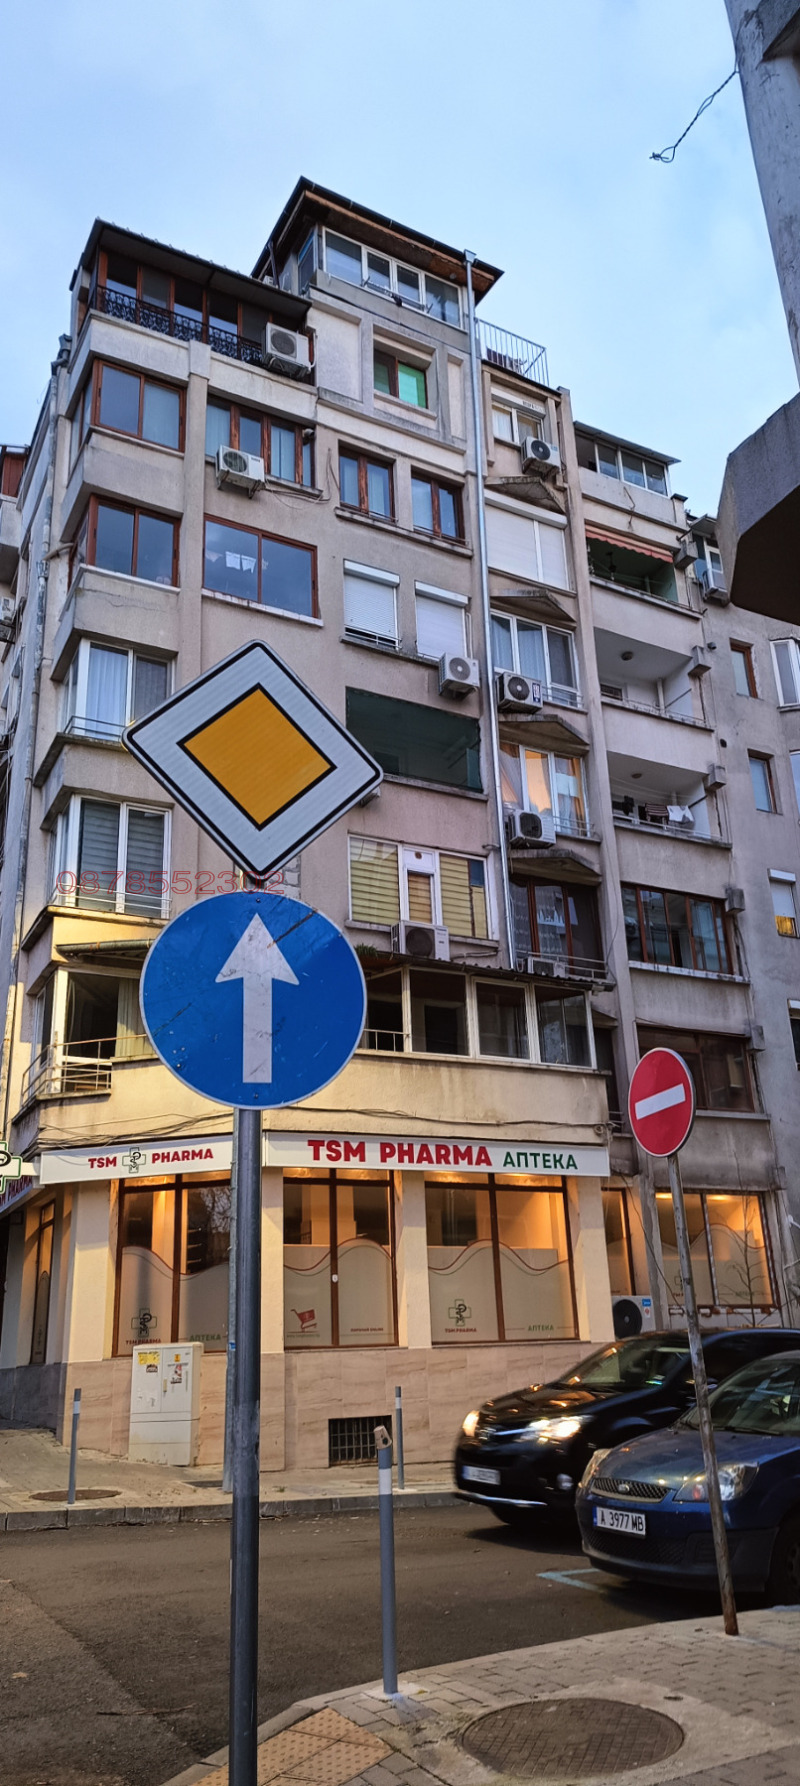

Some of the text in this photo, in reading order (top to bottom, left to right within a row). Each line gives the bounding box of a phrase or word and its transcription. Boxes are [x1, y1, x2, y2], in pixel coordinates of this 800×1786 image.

[88, 1148, 214, 1169] TSM PHARMA
[307, 1139, 493, 1167] TSM PHARMA
[502, 1151, 578, 1170] АПТЕКА
[528, 1324, 554, 1332] АПТЕКА
[600, 1510, 644, 1532] A 3977 MB
